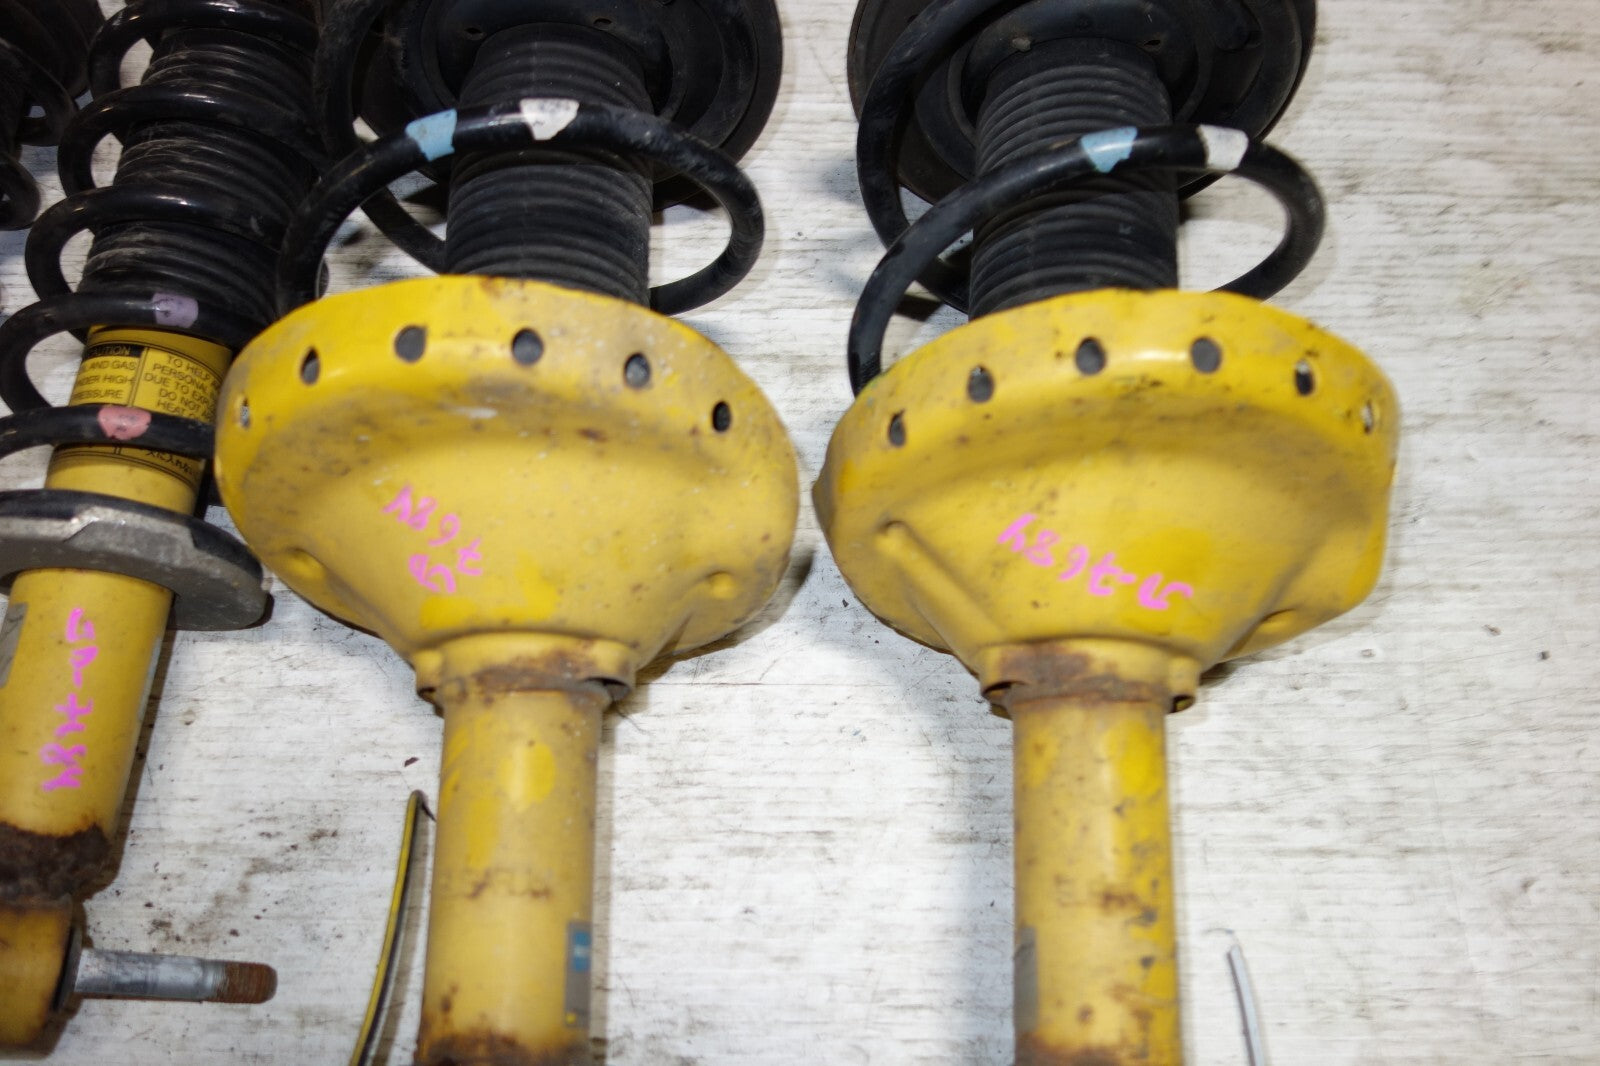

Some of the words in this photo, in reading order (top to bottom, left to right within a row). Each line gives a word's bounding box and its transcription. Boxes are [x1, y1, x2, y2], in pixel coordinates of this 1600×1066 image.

[90, 360, 109, 369] AND
[111, 360, 136, 370] GAS
[167, 355, 182, 368] TO
[187, 363, 210, 380] HELP
[144, 374, 171, 387] DUE
[175, 381, 189, 395] TO
[153, 363, 208, 393] PERSONAL
[160, 388, 177, 401] DO
[180, 396, 201, 412] NOT
